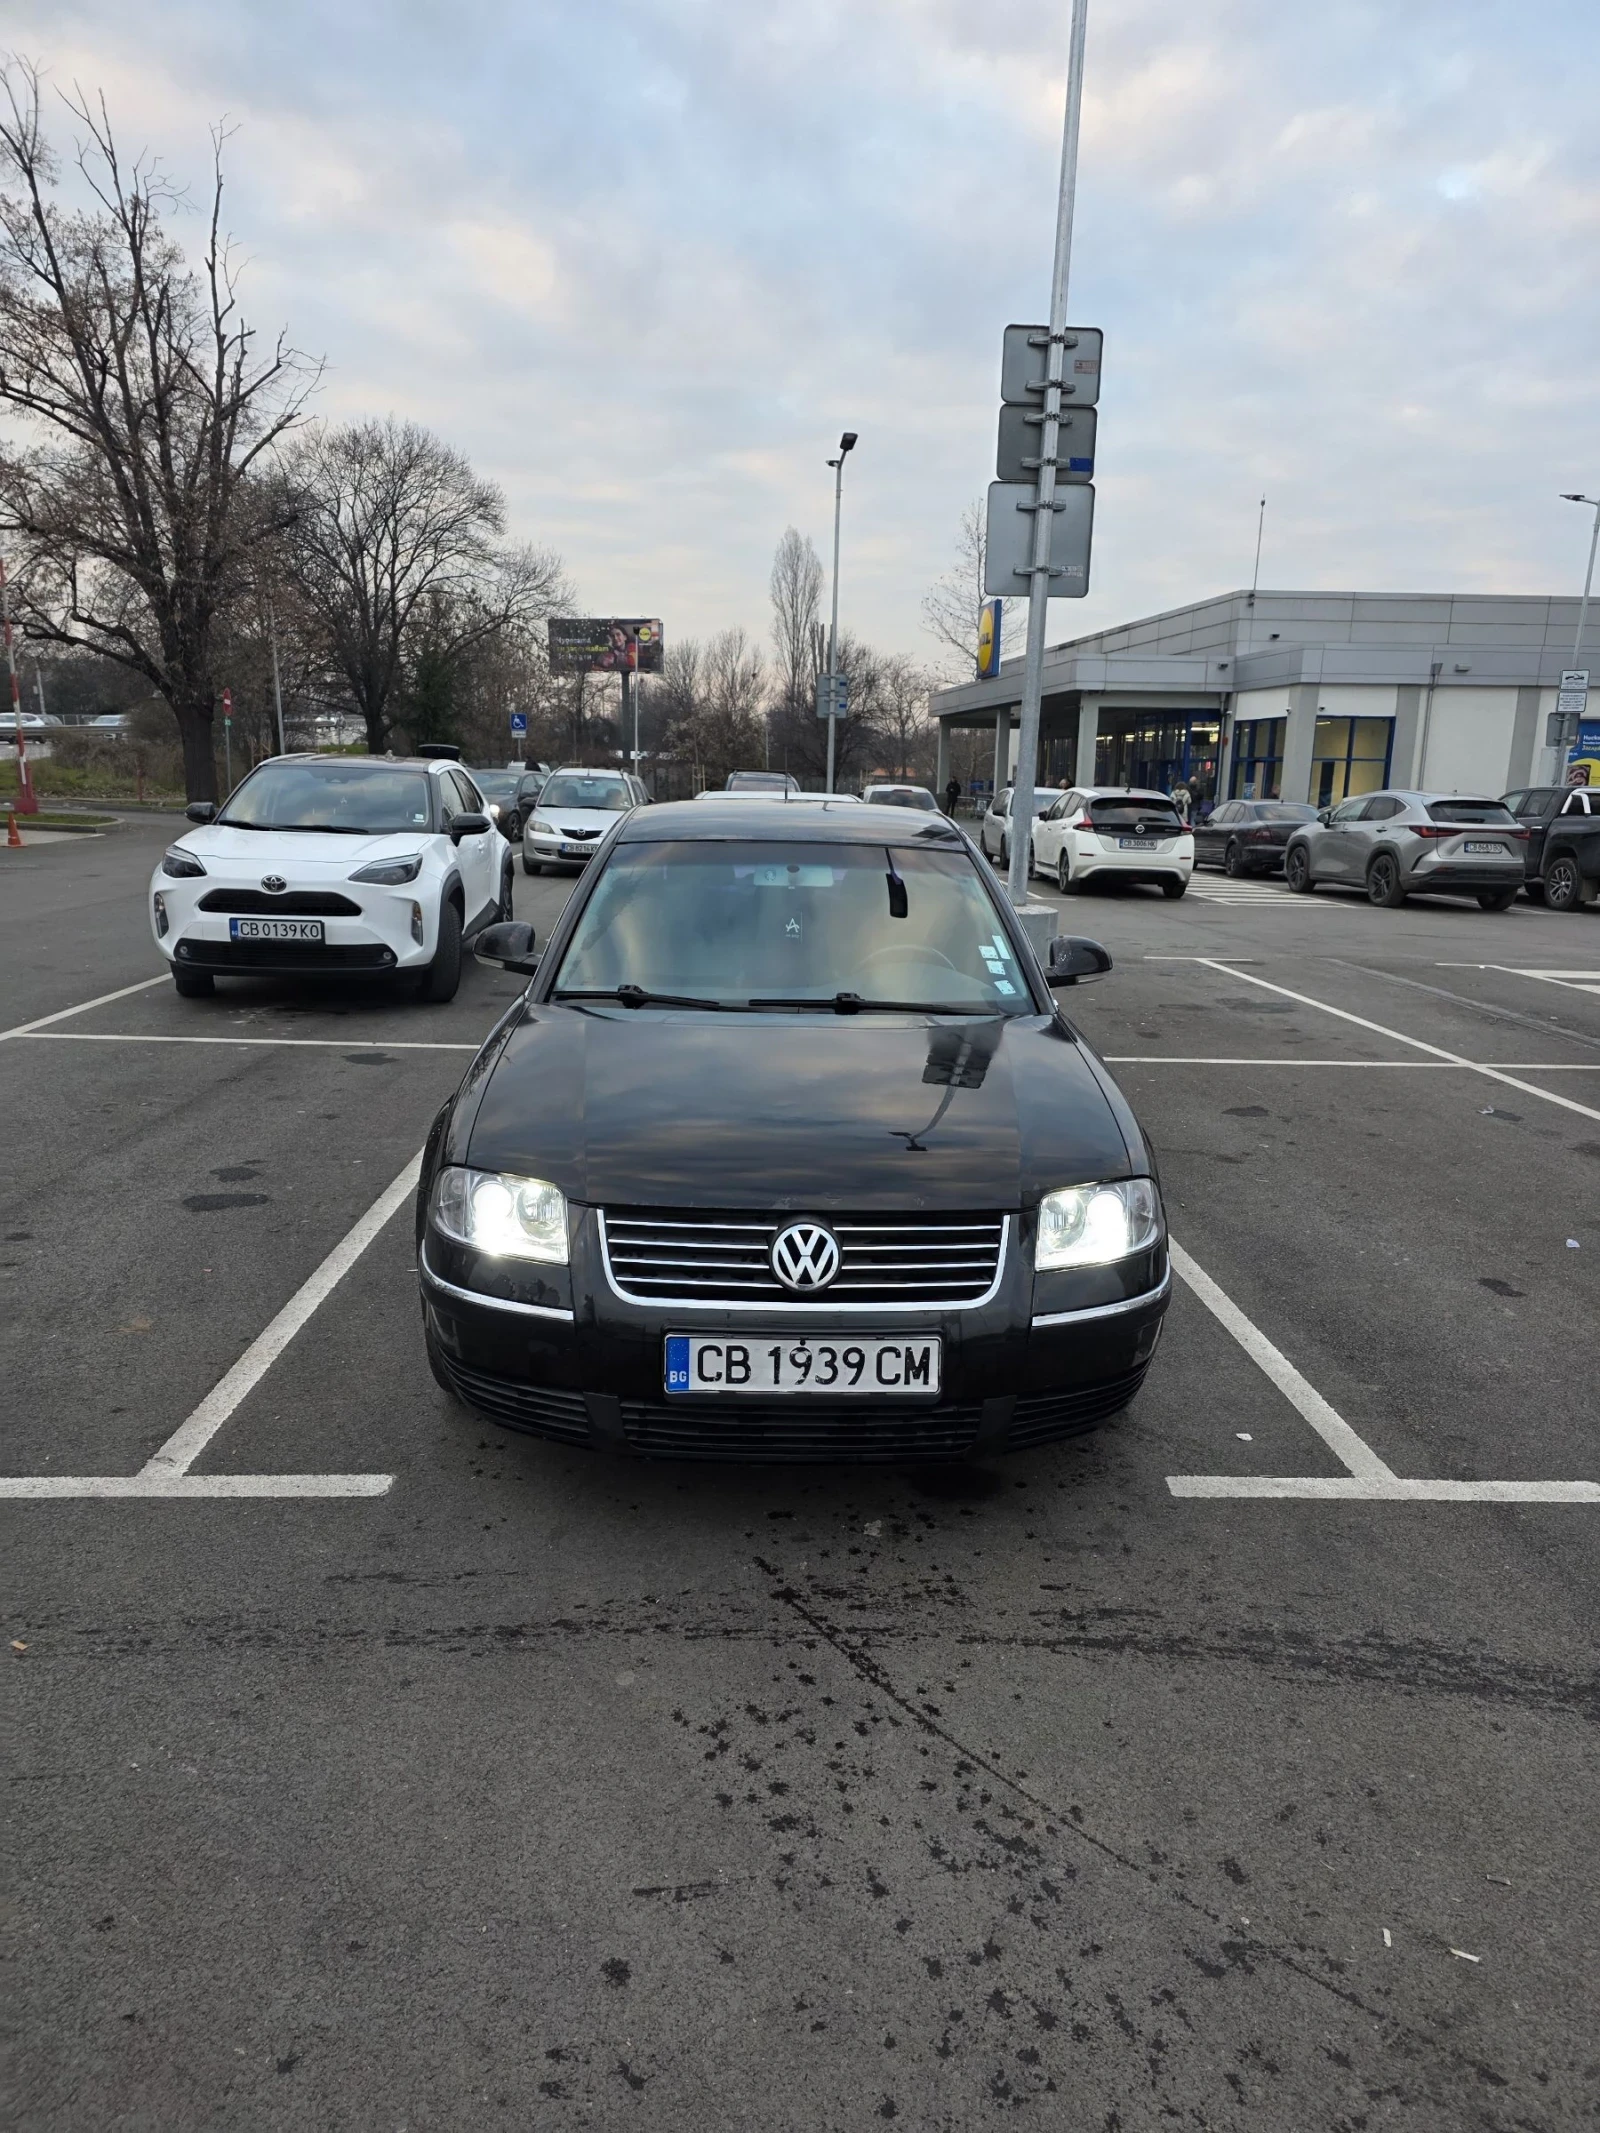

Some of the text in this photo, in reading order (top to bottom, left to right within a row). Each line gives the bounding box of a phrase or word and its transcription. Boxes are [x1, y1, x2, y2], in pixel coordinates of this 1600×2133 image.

[240, 922, 259, 936] CB
[262, 922, 297, 937] 0139
[773, 1225, 838, 1290] VW
[669, 1371, 687, 1383] BG
[697, 1345, 930, 1385] CB 1939 CM
